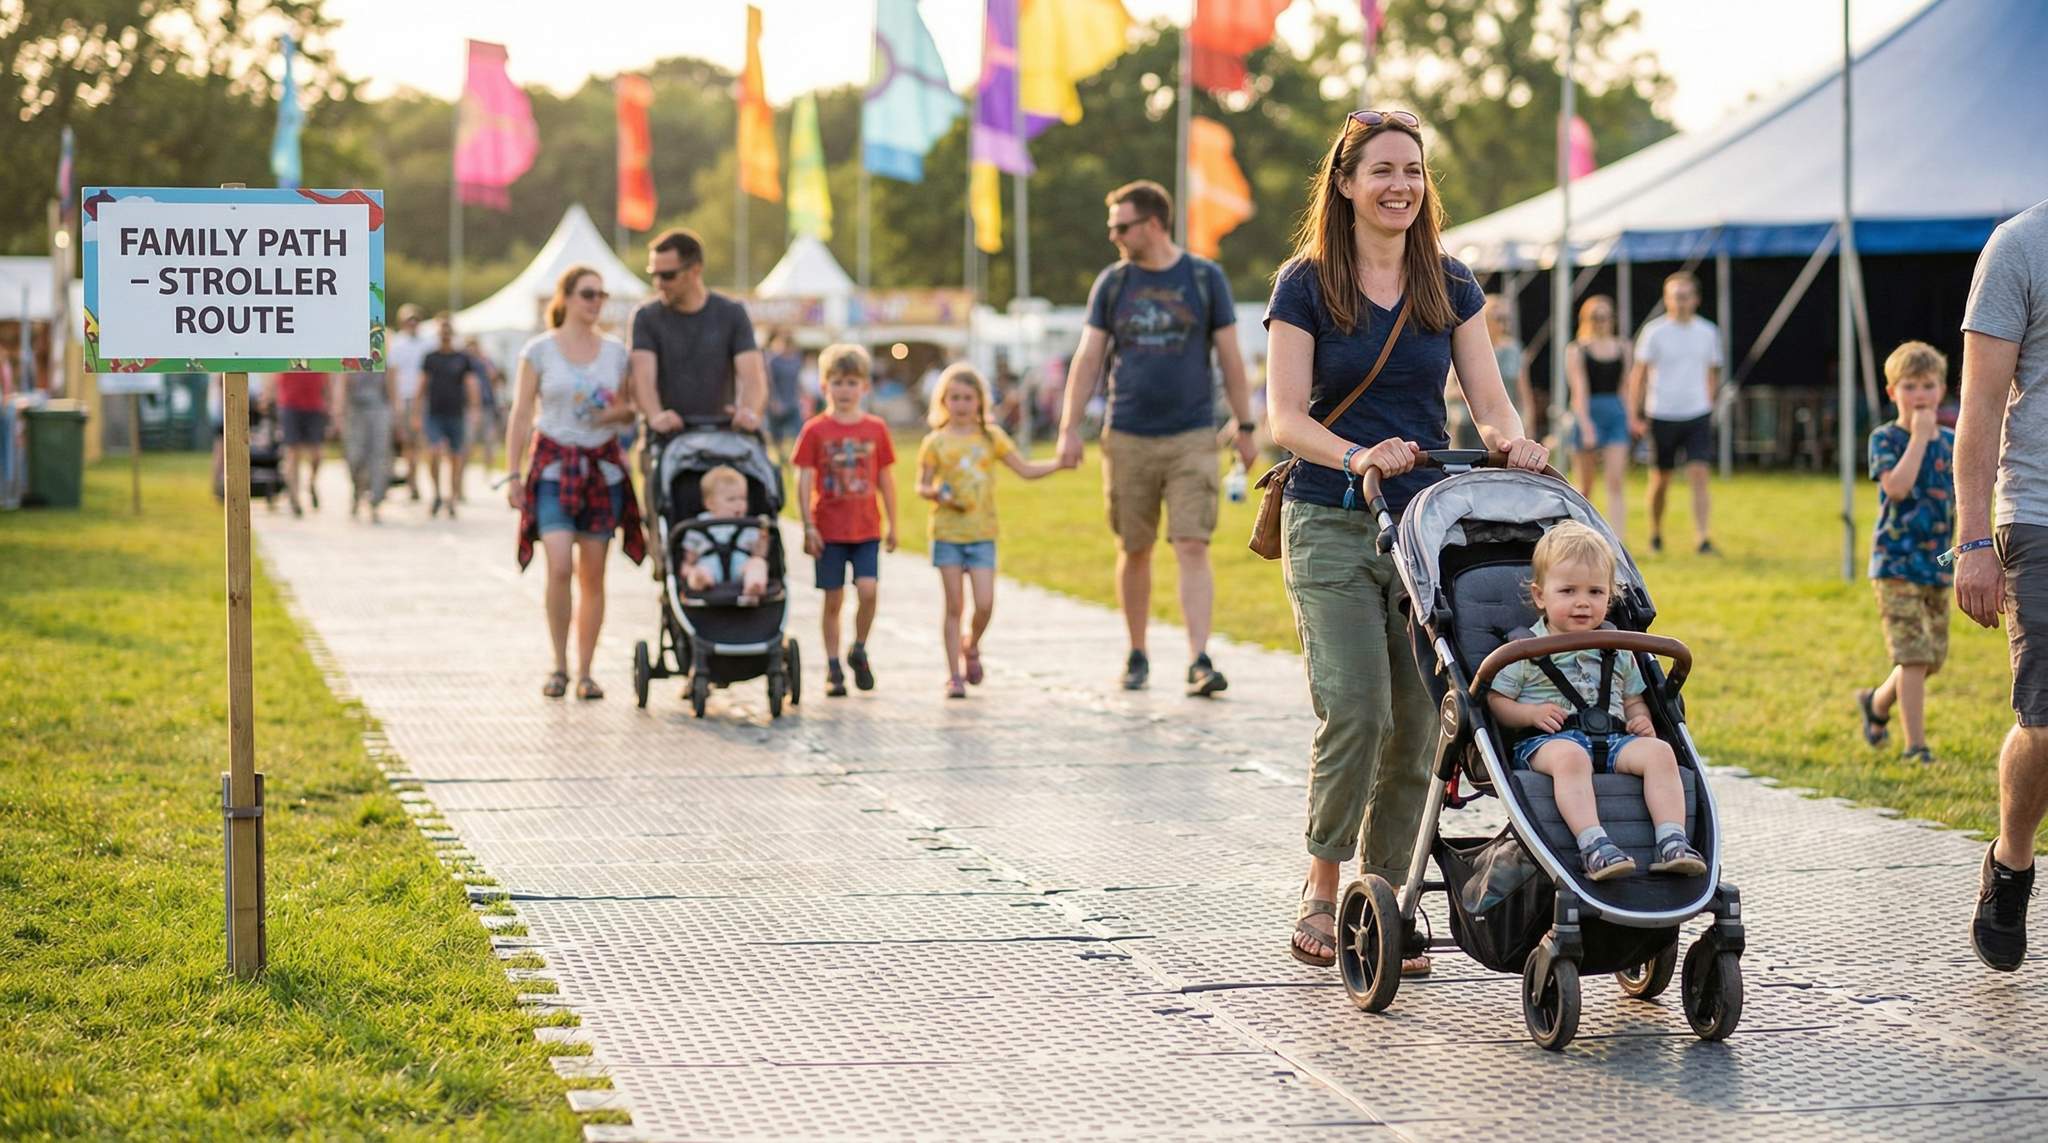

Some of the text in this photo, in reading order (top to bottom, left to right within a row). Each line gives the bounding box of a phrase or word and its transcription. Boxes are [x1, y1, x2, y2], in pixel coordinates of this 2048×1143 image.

[120, 227, 347, 257] FAMILY PATH
[158, 267, 338, 296] STROLLER
[175, 305, 295, 335] ROUTE
